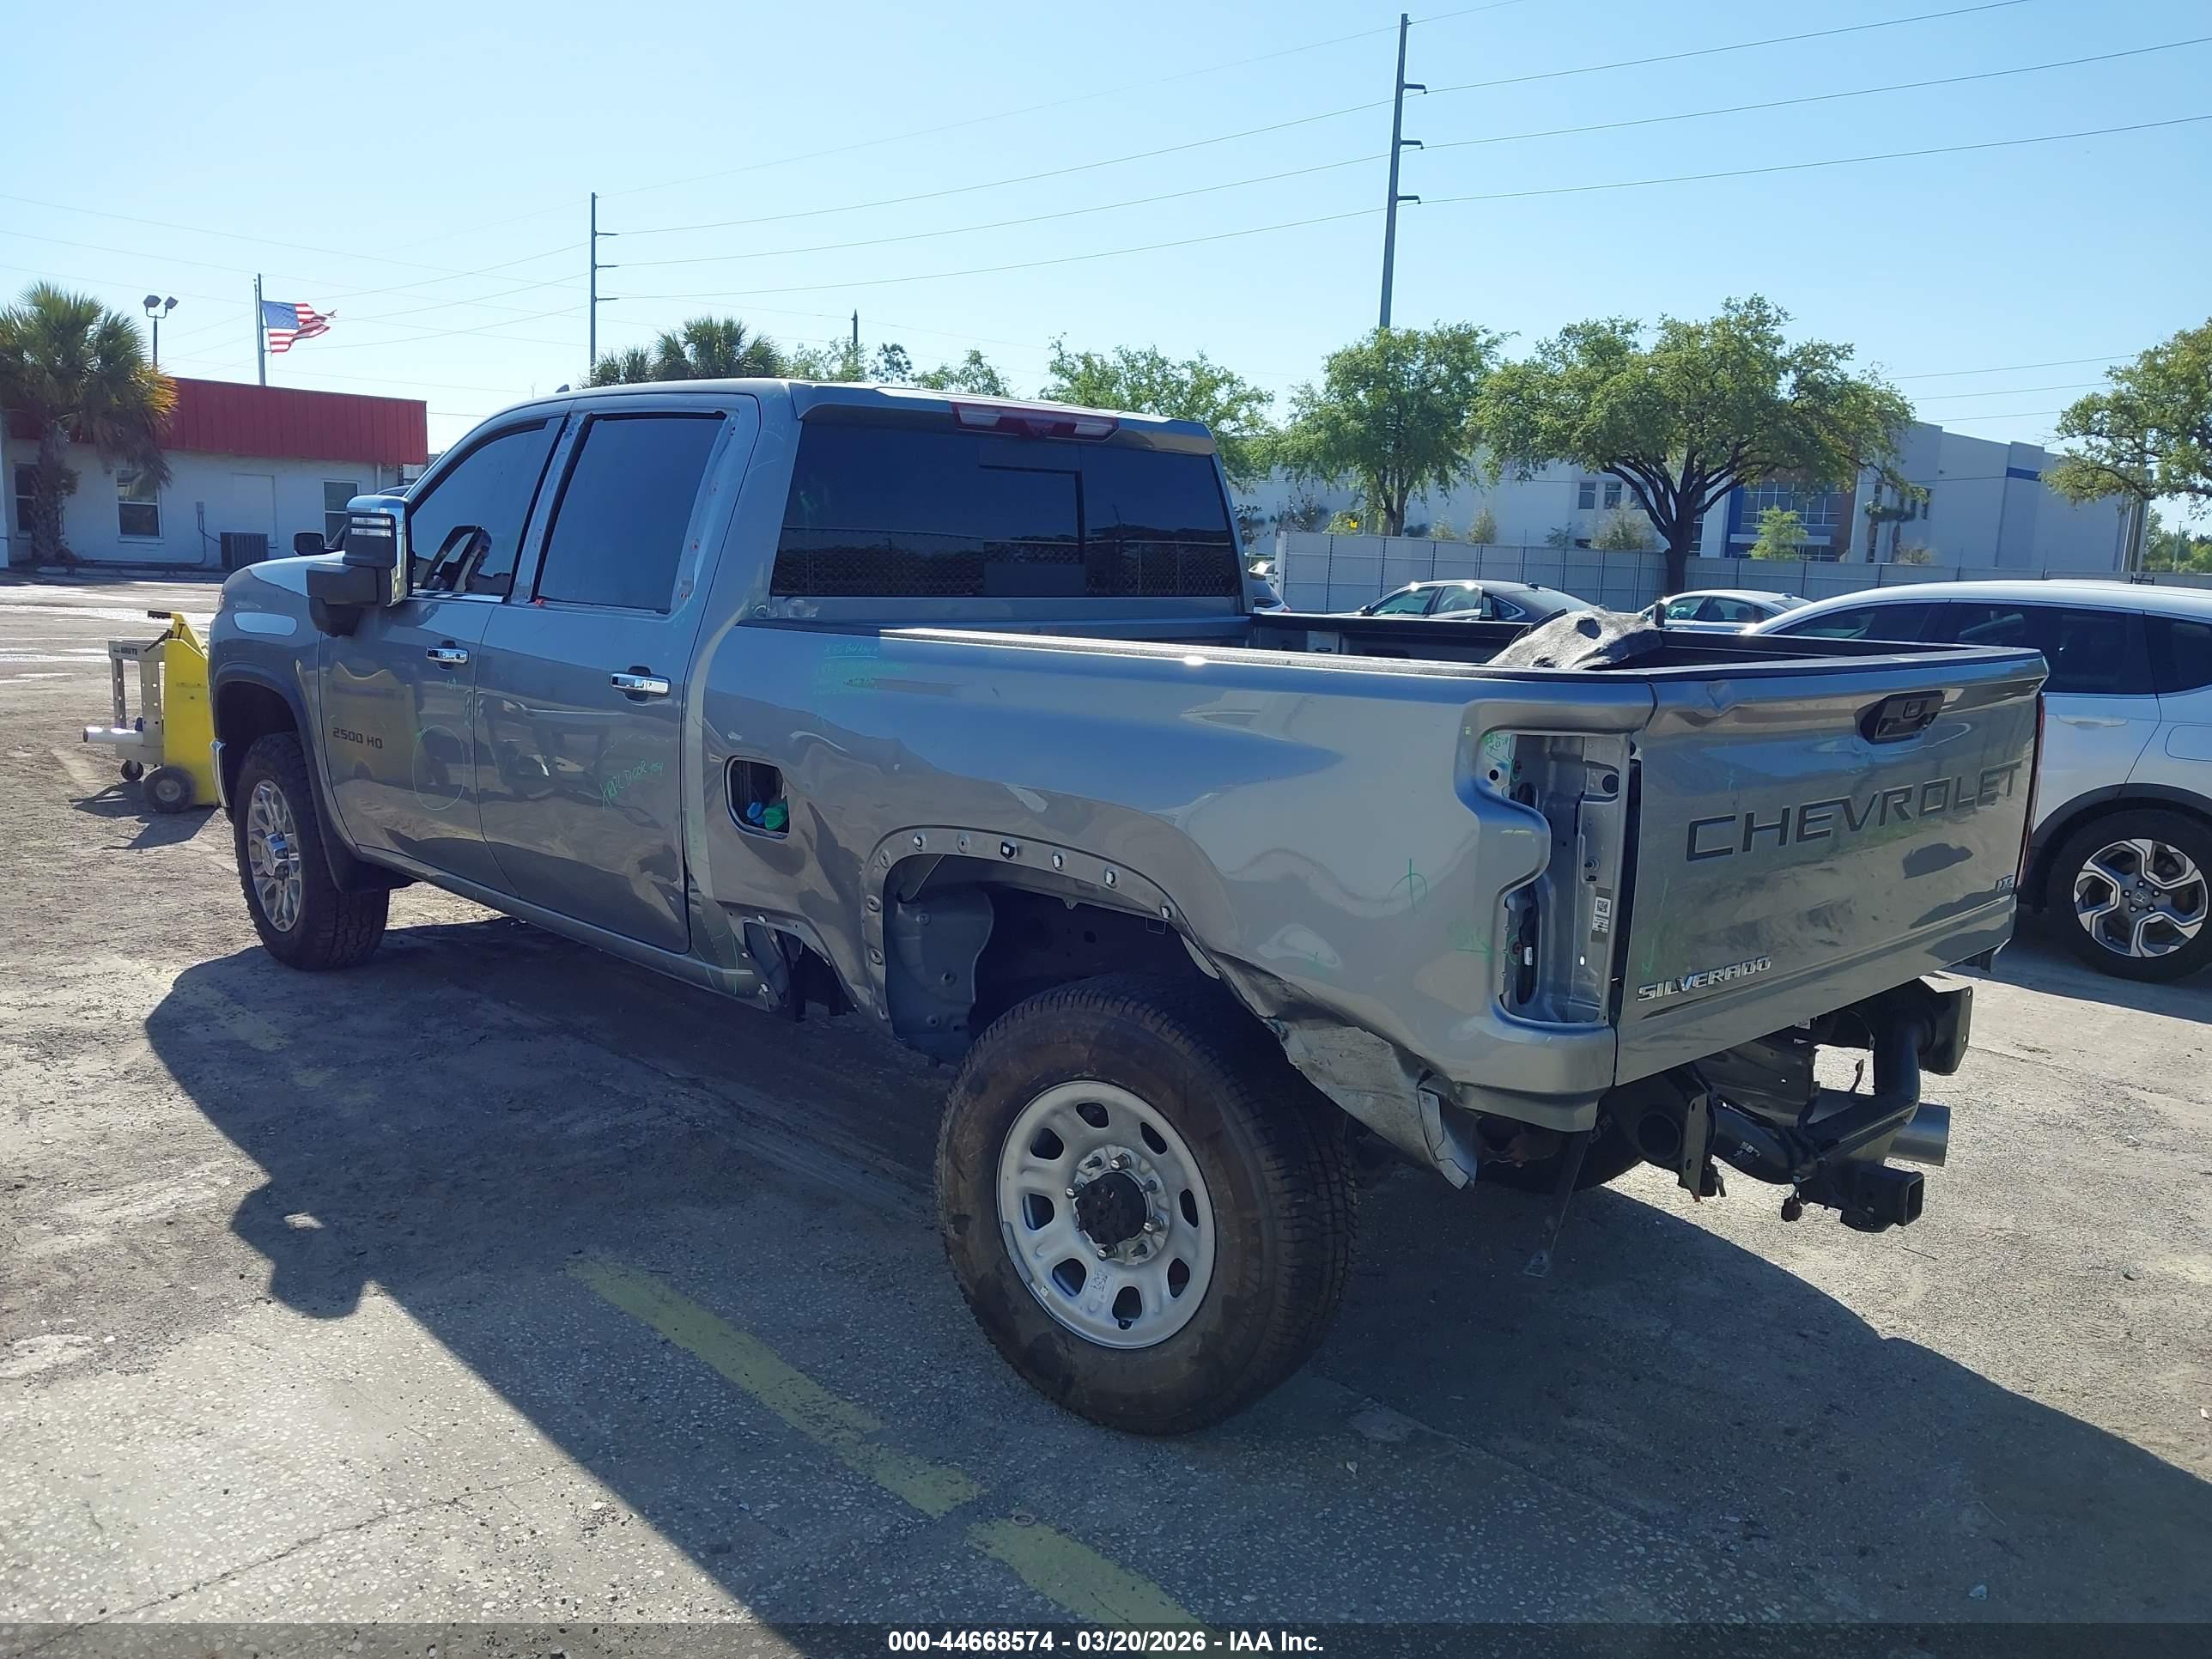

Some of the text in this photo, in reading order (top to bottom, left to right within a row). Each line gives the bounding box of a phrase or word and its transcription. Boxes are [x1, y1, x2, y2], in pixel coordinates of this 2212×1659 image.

[332, 727, 363, 744] 2500
[1686, 758, 2022, 861] CHEVROLET
[1637, 955, 1771, 1002] SILVERADO
